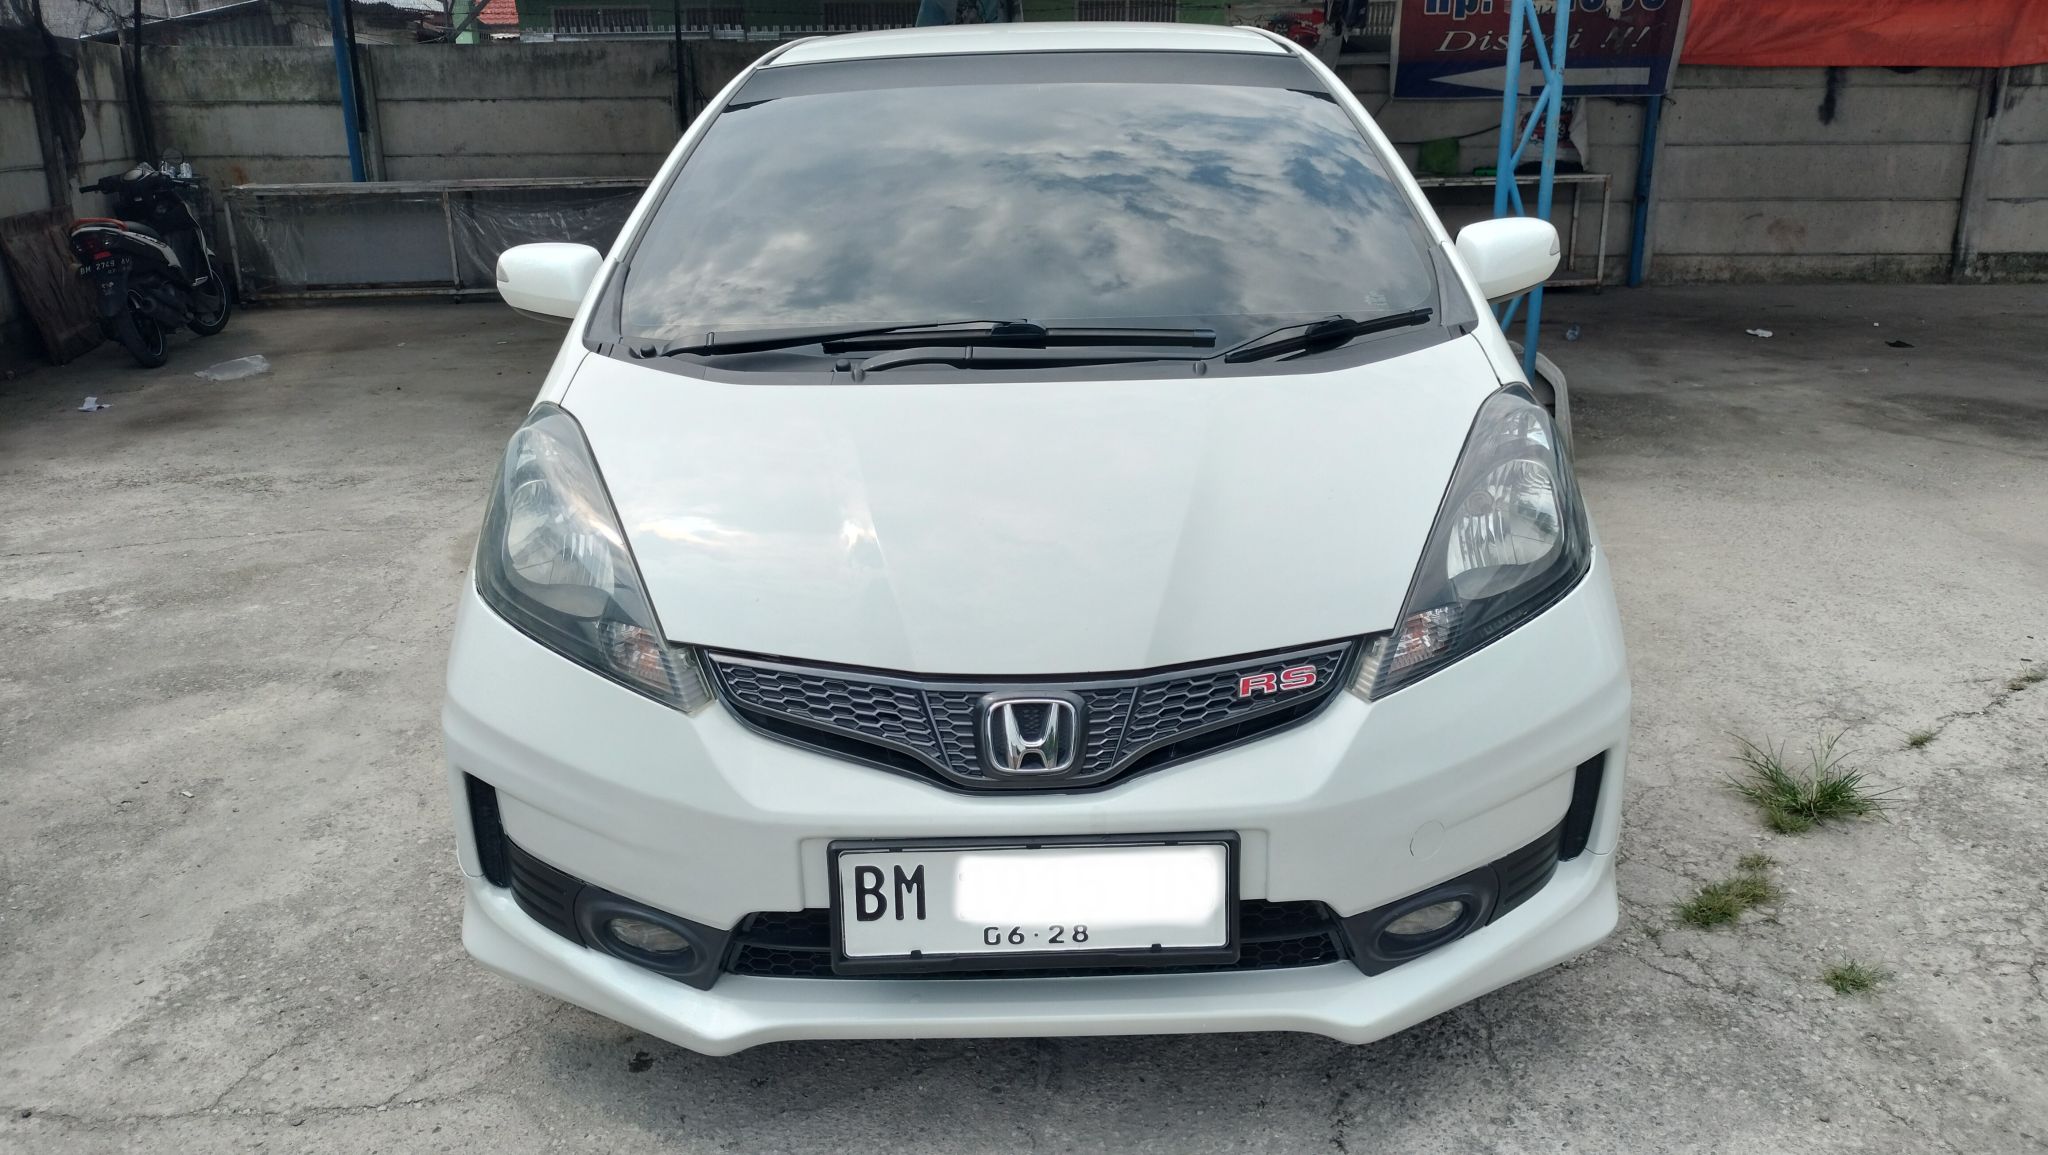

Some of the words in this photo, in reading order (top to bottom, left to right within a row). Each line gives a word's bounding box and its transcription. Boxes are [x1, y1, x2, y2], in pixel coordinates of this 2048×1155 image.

[1434, 29, 1583, 52] Disii
[1239, 665, 1317, 698] RS
[854, 864, 926, 922] BM
